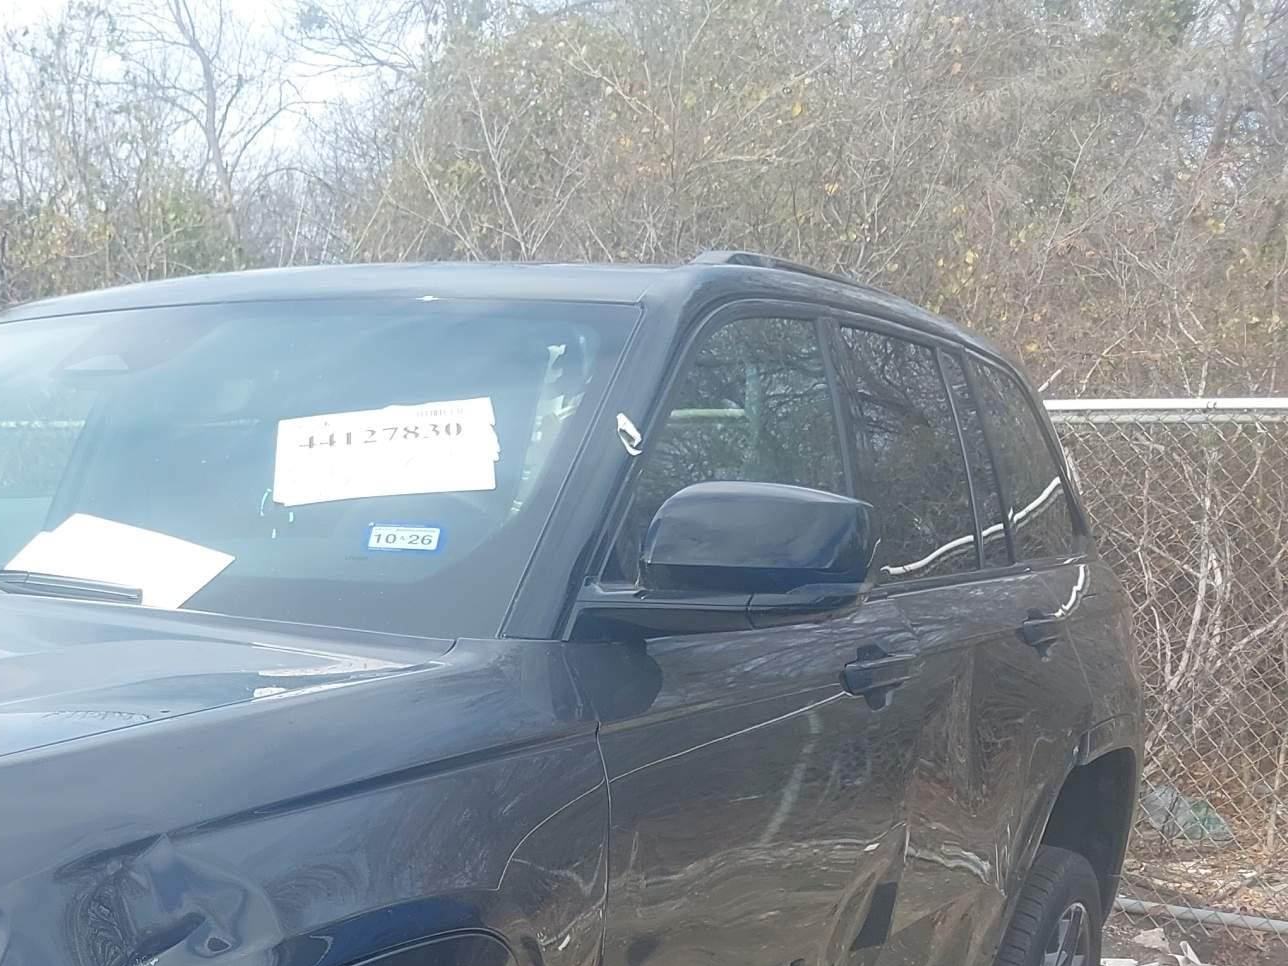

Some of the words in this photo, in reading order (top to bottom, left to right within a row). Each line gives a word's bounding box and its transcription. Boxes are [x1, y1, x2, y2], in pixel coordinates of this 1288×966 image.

[299, 422, 462, 449] 44127830
[374, 533, 397, 544] 10
[408, 534, 433, 545] 26
